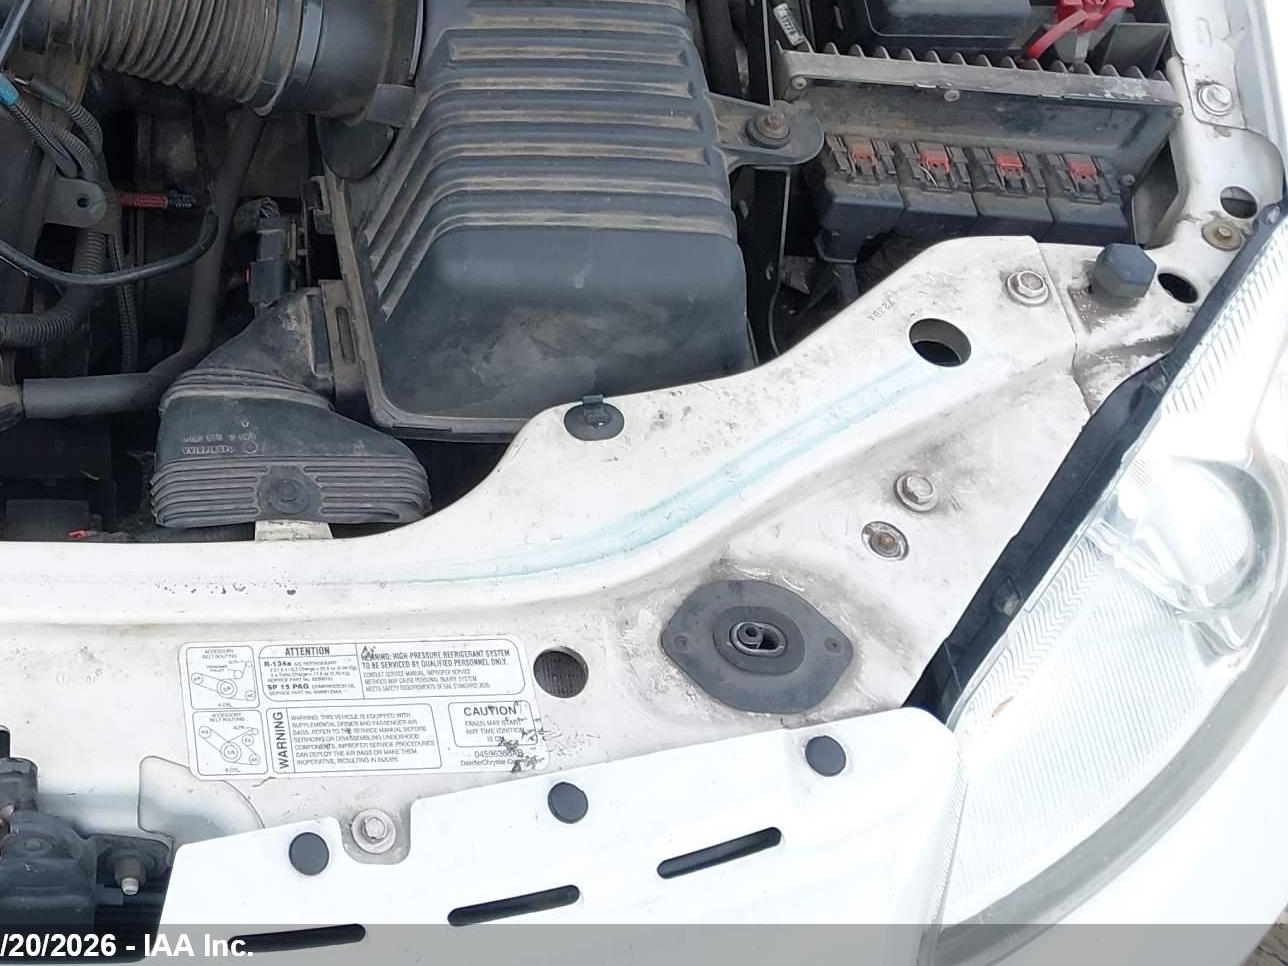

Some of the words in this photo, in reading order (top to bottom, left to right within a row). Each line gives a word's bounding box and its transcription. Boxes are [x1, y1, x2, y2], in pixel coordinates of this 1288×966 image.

[285, 646, 330, 656] ATTENTION
[410, 651, 442, 659] PRESSURE
[443, 650, 484, 658] REFRIGERANT
[381, 661, 410, 669] SERVICED
[412, 660, 420, 668] BY
[454, 659, 490, 667] PERSONNEL
[464, 706, 517, 716] CAUTION
[272, 711, 289, 769] WARNING
